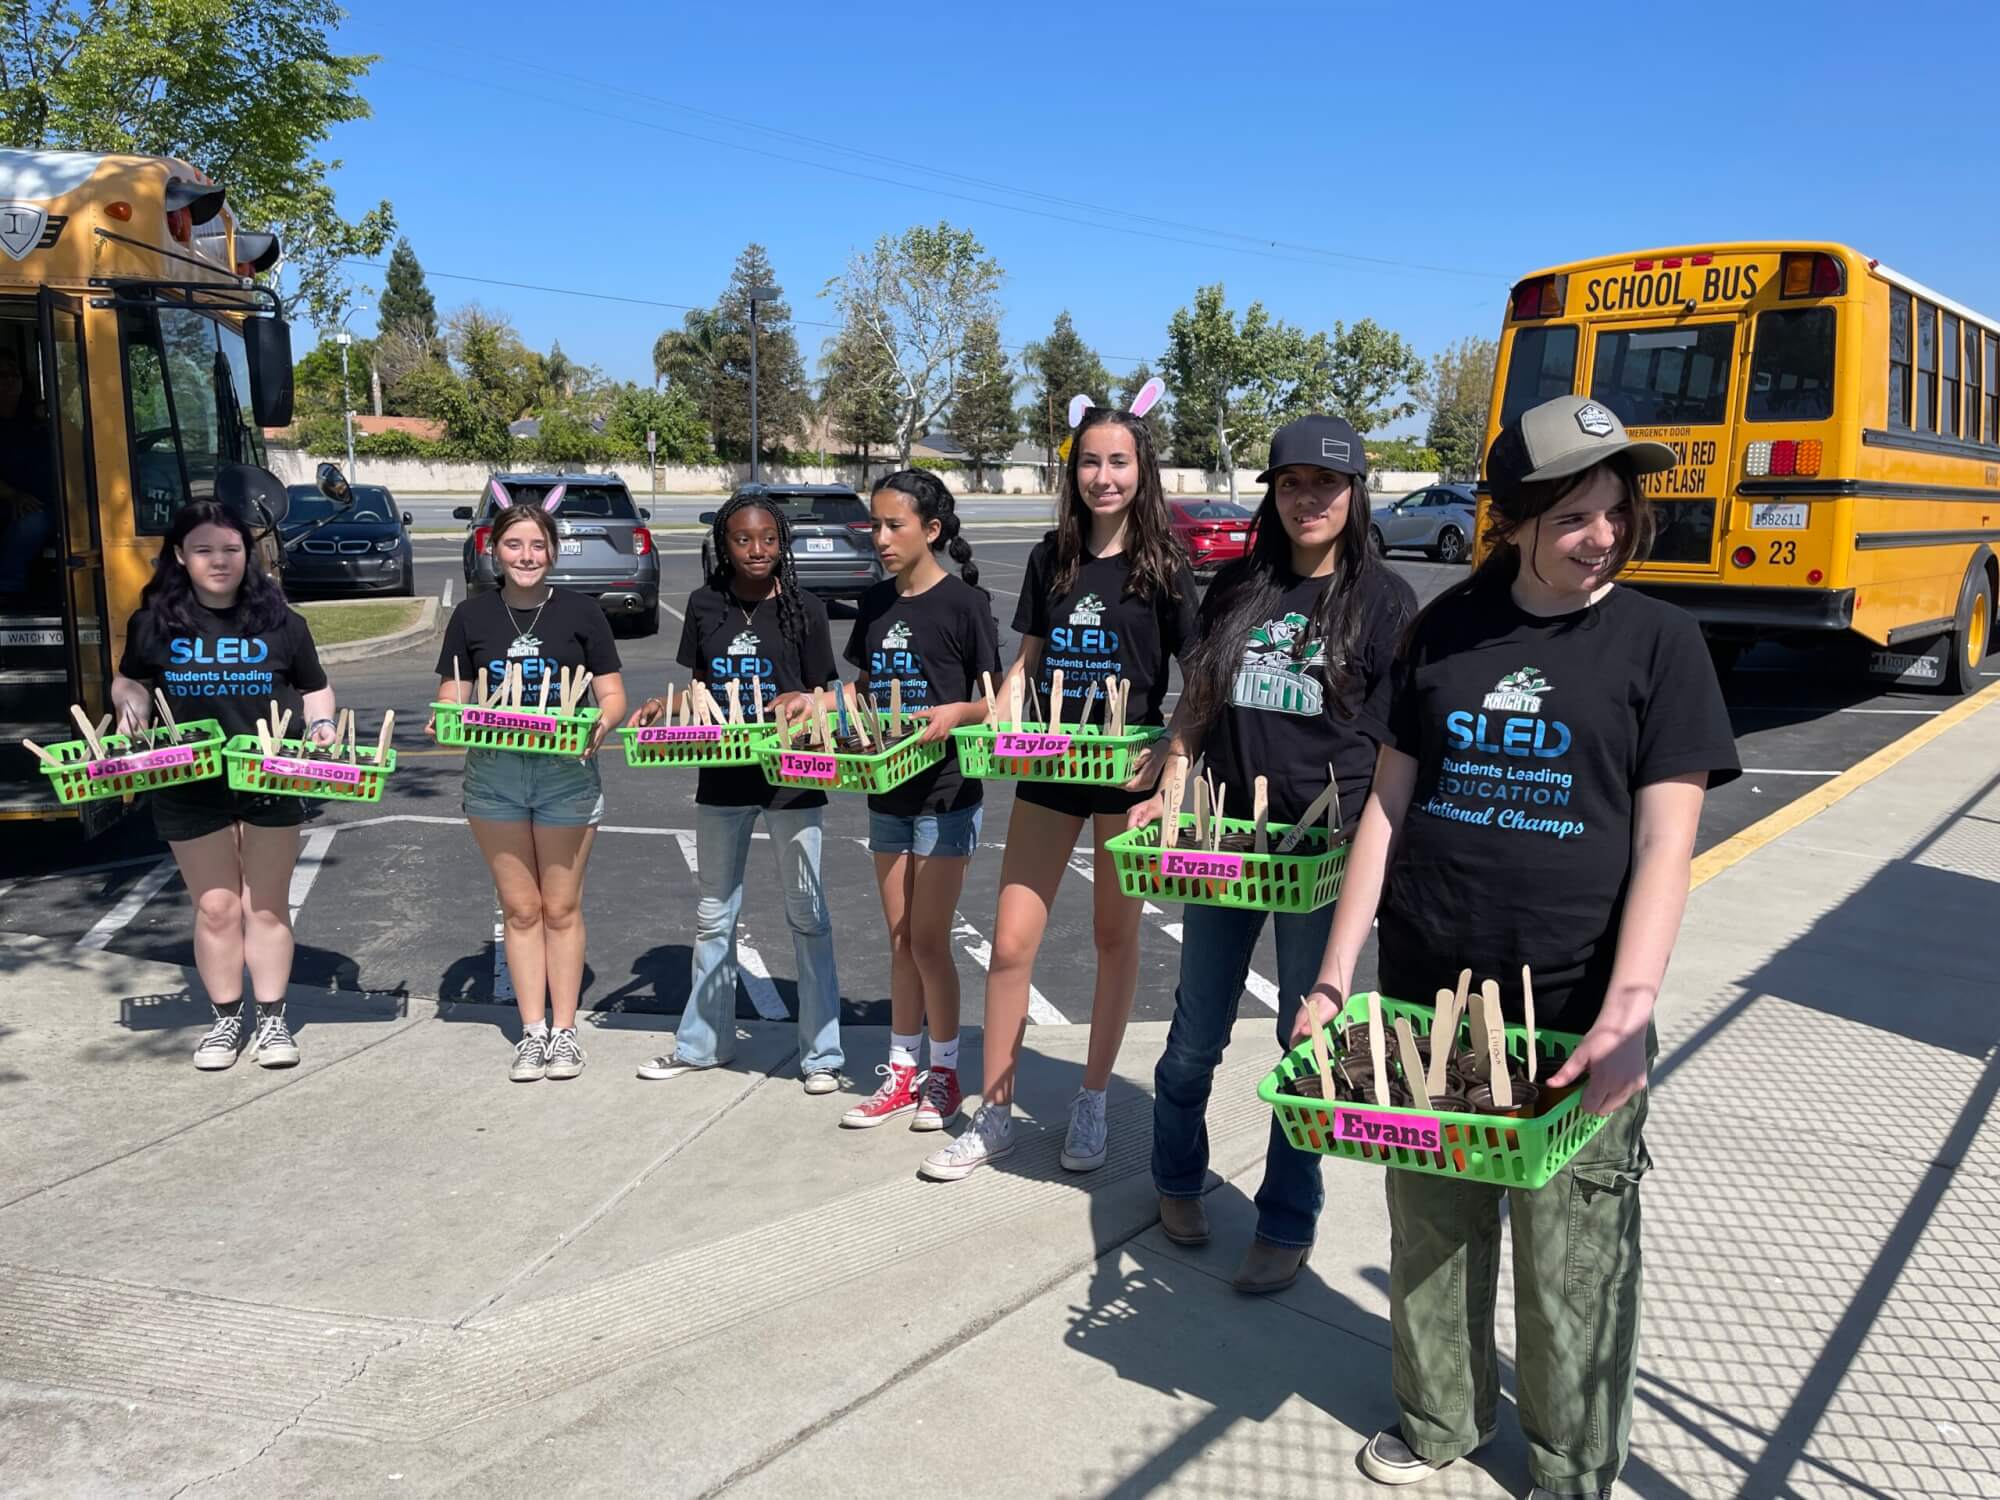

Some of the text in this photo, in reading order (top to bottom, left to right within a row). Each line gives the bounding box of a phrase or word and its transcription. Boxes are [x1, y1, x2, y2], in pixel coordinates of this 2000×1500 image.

[1586, 264, 1759, 313] SCHOOL BUS
[1669, 427, 1691, 437] DOOR
[1664, 441, 1717, 465] EN RED
[1665, 468, 1706, 494] FLASH
[1769, 541, 1796, 565] 23
[8, 632, 45, 643] WATCH
[49, 632, 63, 642] YO
[1050, 627, 1119, 654] SLED
[169, 636, 269, 664] SLED
[489, 656, 559, 680] SED
[711, 656, 774, 678] SLED
[1046, 657, 1122, 672] Students Leading
[164, 670, 273, 683] Students Leading
[745, 682, 777, 692] Leding
[167, 684, 273, 697] EDUCATION
[1232, 673, 1323, 715] NIGHTS
[1482, 691, 1541, 713] KNIGHTS
[467, 711, 552, 731] O'Bannan
[641, 730, 717, 741] O'Bannan
[1002, 735, 1068, 754] Taylor
[1447, 711, 1571, 758] SLED
[785, 755, 833, 774] Taylor
[1442, 757, 1572, 787] Students Leading
[1439, 775, 1570, 806] EDUCATION
[1422, 796, 1584, 840] National Champs
[1166, 855, 1239, 878] Evans
[1342, 1112, 1438, 1148] Evans
